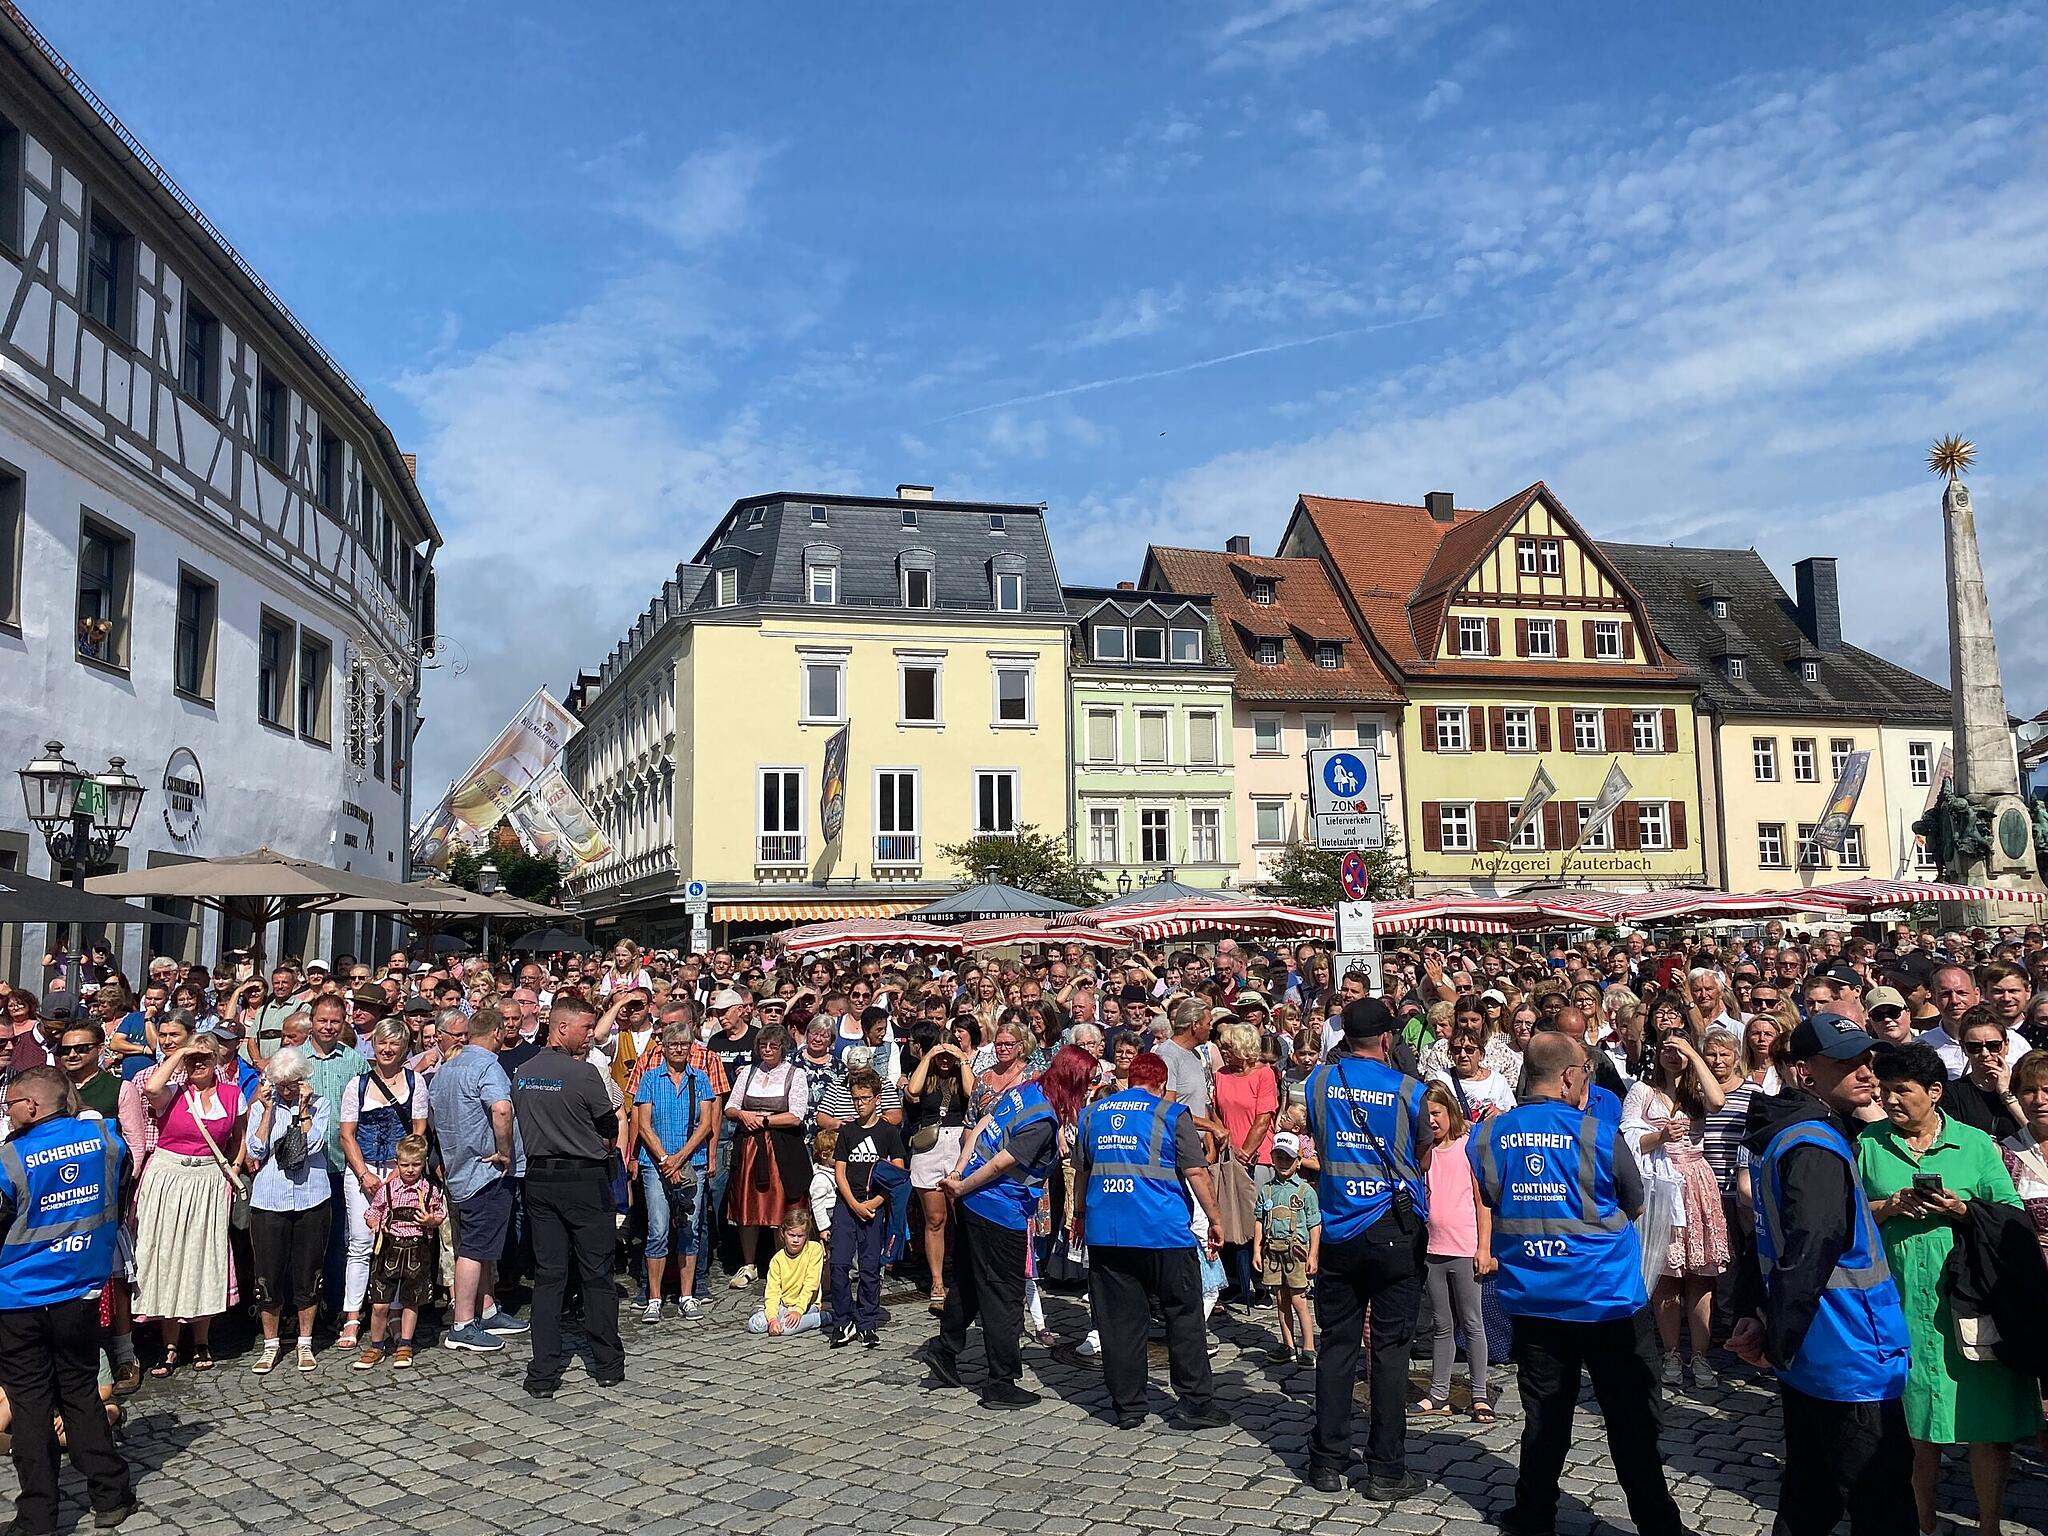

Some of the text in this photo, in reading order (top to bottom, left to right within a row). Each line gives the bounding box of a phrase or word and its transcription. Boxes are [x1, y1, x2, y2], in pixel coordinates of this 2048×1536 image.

[520, 716, 560, 751] KULMBACHER
[1331, 800, 1361, 812] ZON
[1325, 816, 1372, 825] Lieferverkehr
[1343, 827, 1356, 835] und
[1366, 836, 1379, 846] frei
[1471, 857, 1551, 874] Metzgerei
[928, 913, 954, 921] IMBISS
[979, 912, 997, 920] DER
[1097, 1101, 1150, 1112] SICHERHEIT
[1098, 1135, 1138, 1145] CONTINUS
[1500, 1132, 1573, 1149] SICHERHEIT
[25, 1138, 102, 1169] SICHERHEIT
[1103, 1179, 1135, 1193] 3203
[1511, 1183, 1567, 1194] CONTINUS
[40, 1184, 99, 1205] CONTINUS
[50, 1234, 92, 1253] 3161
[1523, 1240, 1568, 1257] 3172
